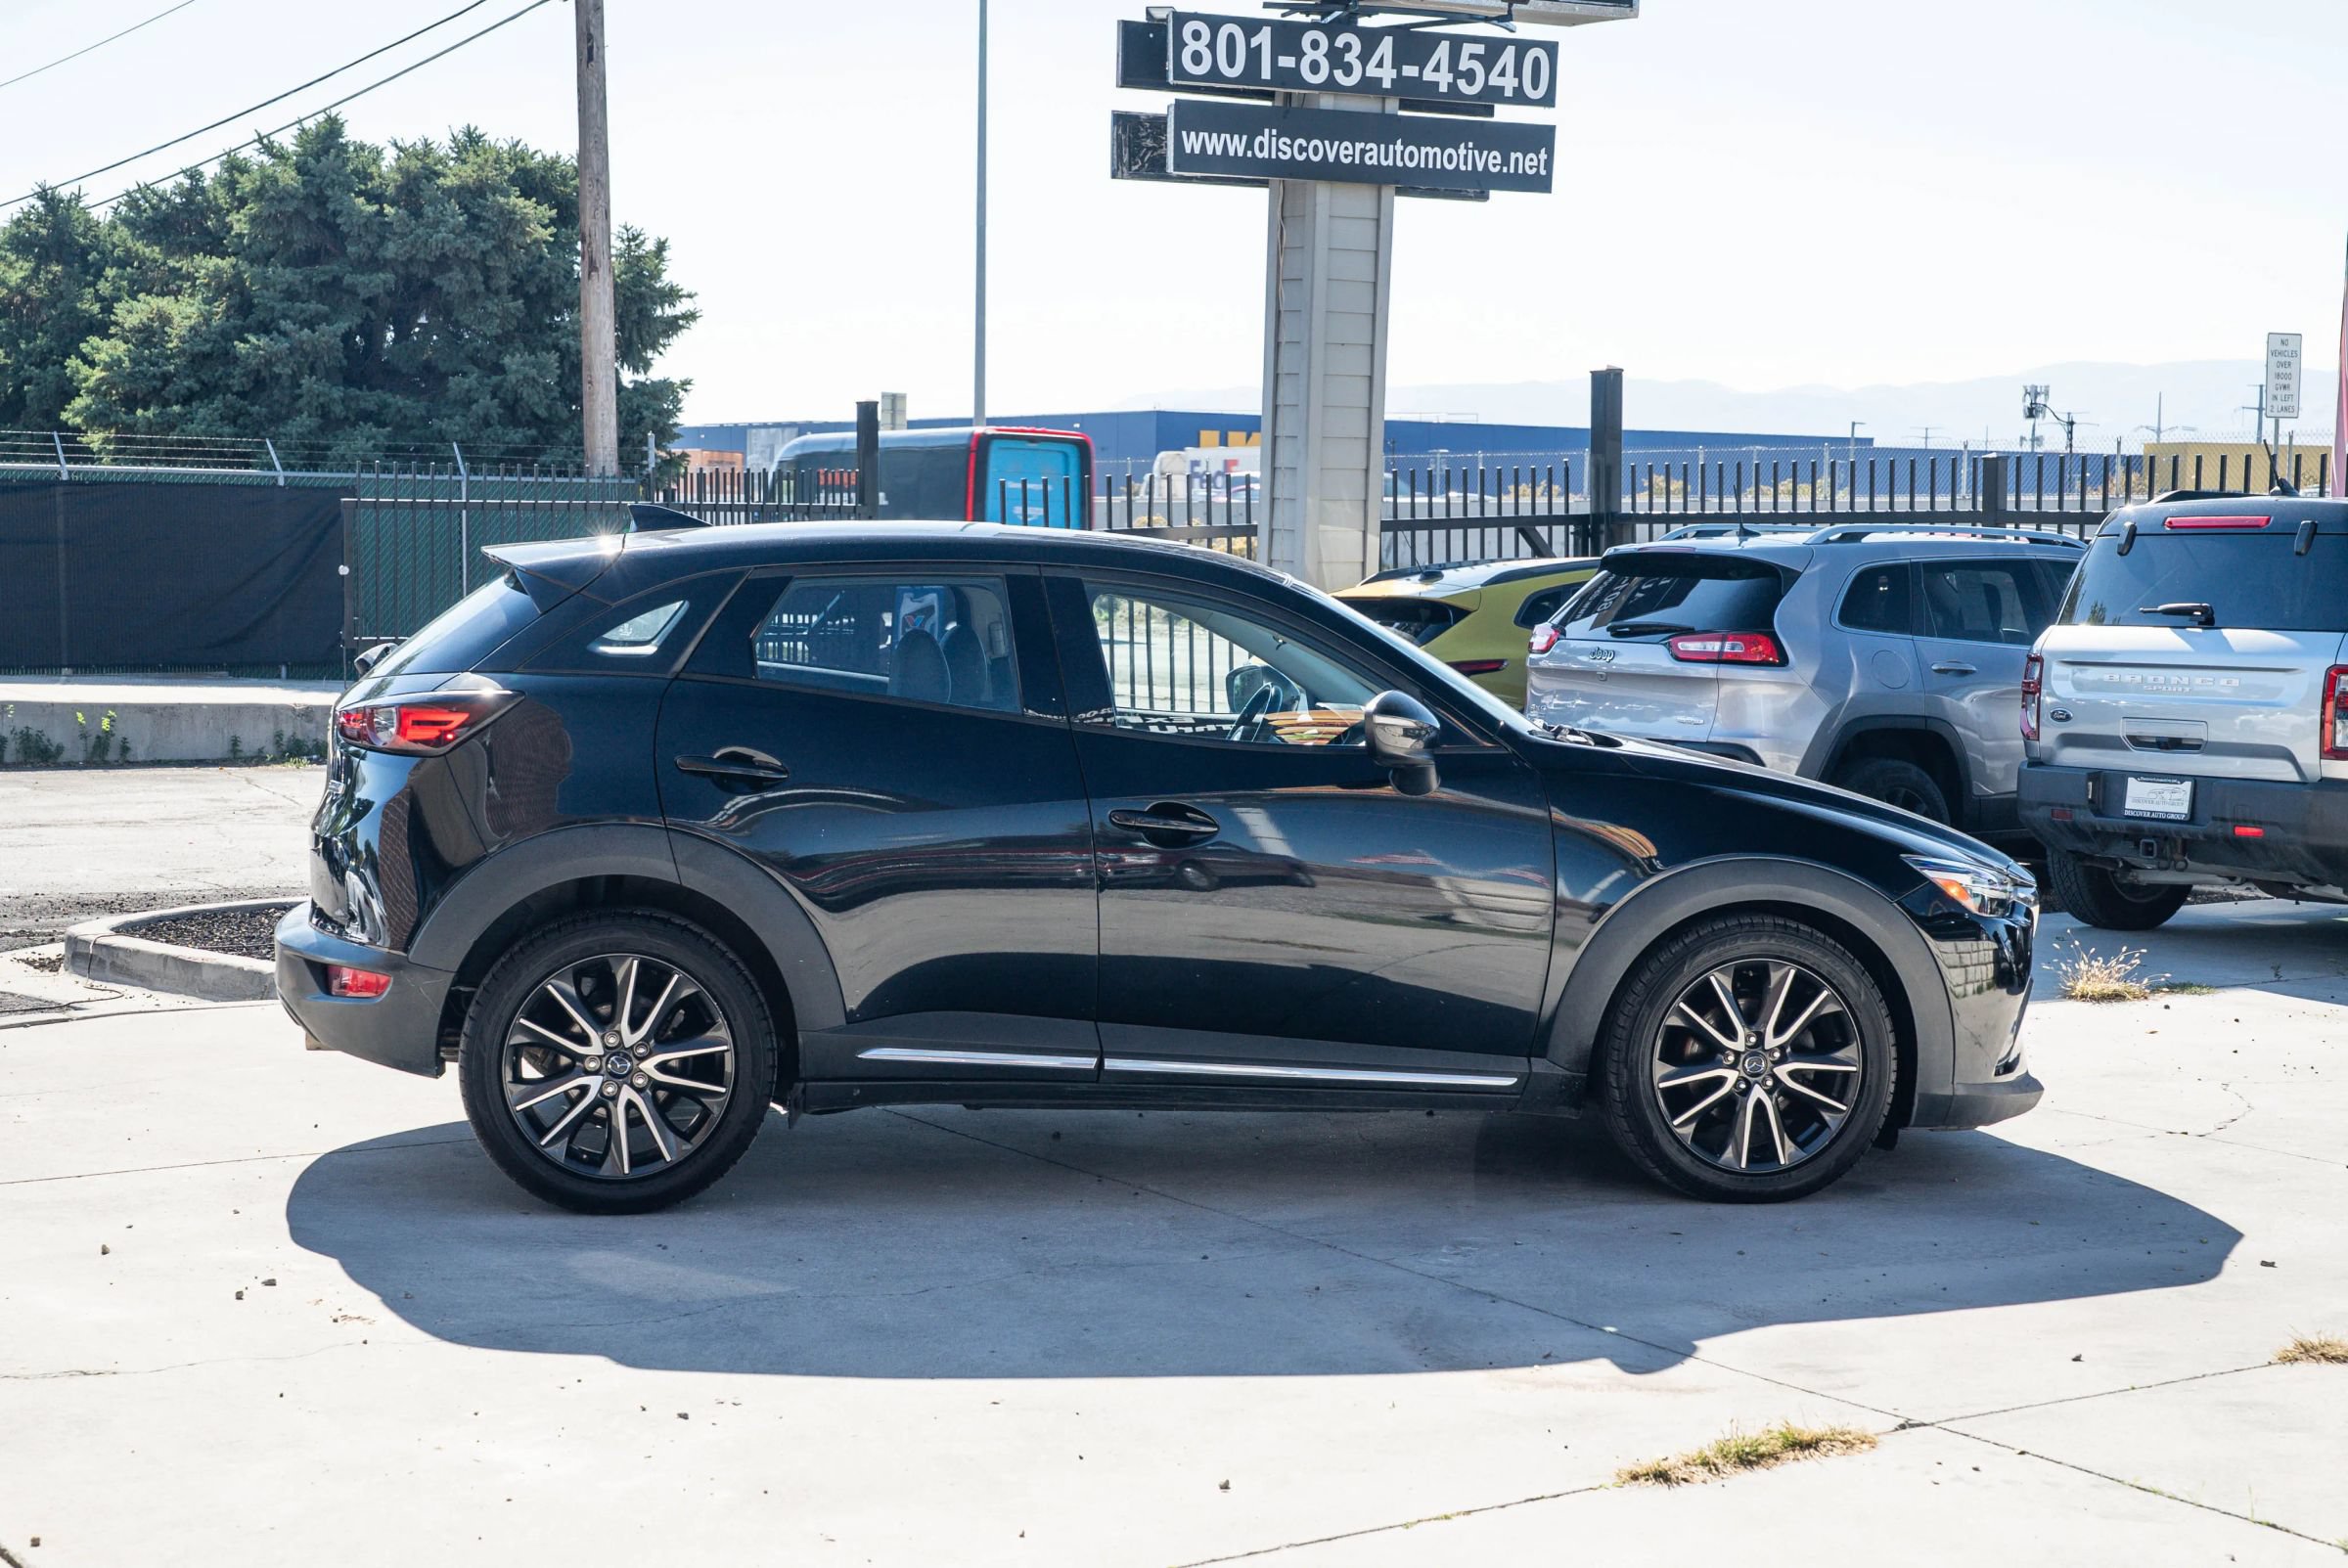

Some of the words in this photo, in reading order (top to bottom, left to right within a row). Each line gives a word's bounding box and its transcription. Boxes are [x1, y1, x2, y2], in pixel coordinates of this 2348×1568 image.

[1181, 20, 1550, 100] 801-834-4540
[1182, 128, 1548, 176] www.discoverautomotive.net
[2270, 349, 2298, 358] VEHICLES
[2280, 393, 2293, 402] LEFT
[1589, 647, 1615, 663] Jeep
[2103, 673, 2240, 687] BRONCO
[2143, 684, 2192, 693] SPORT
